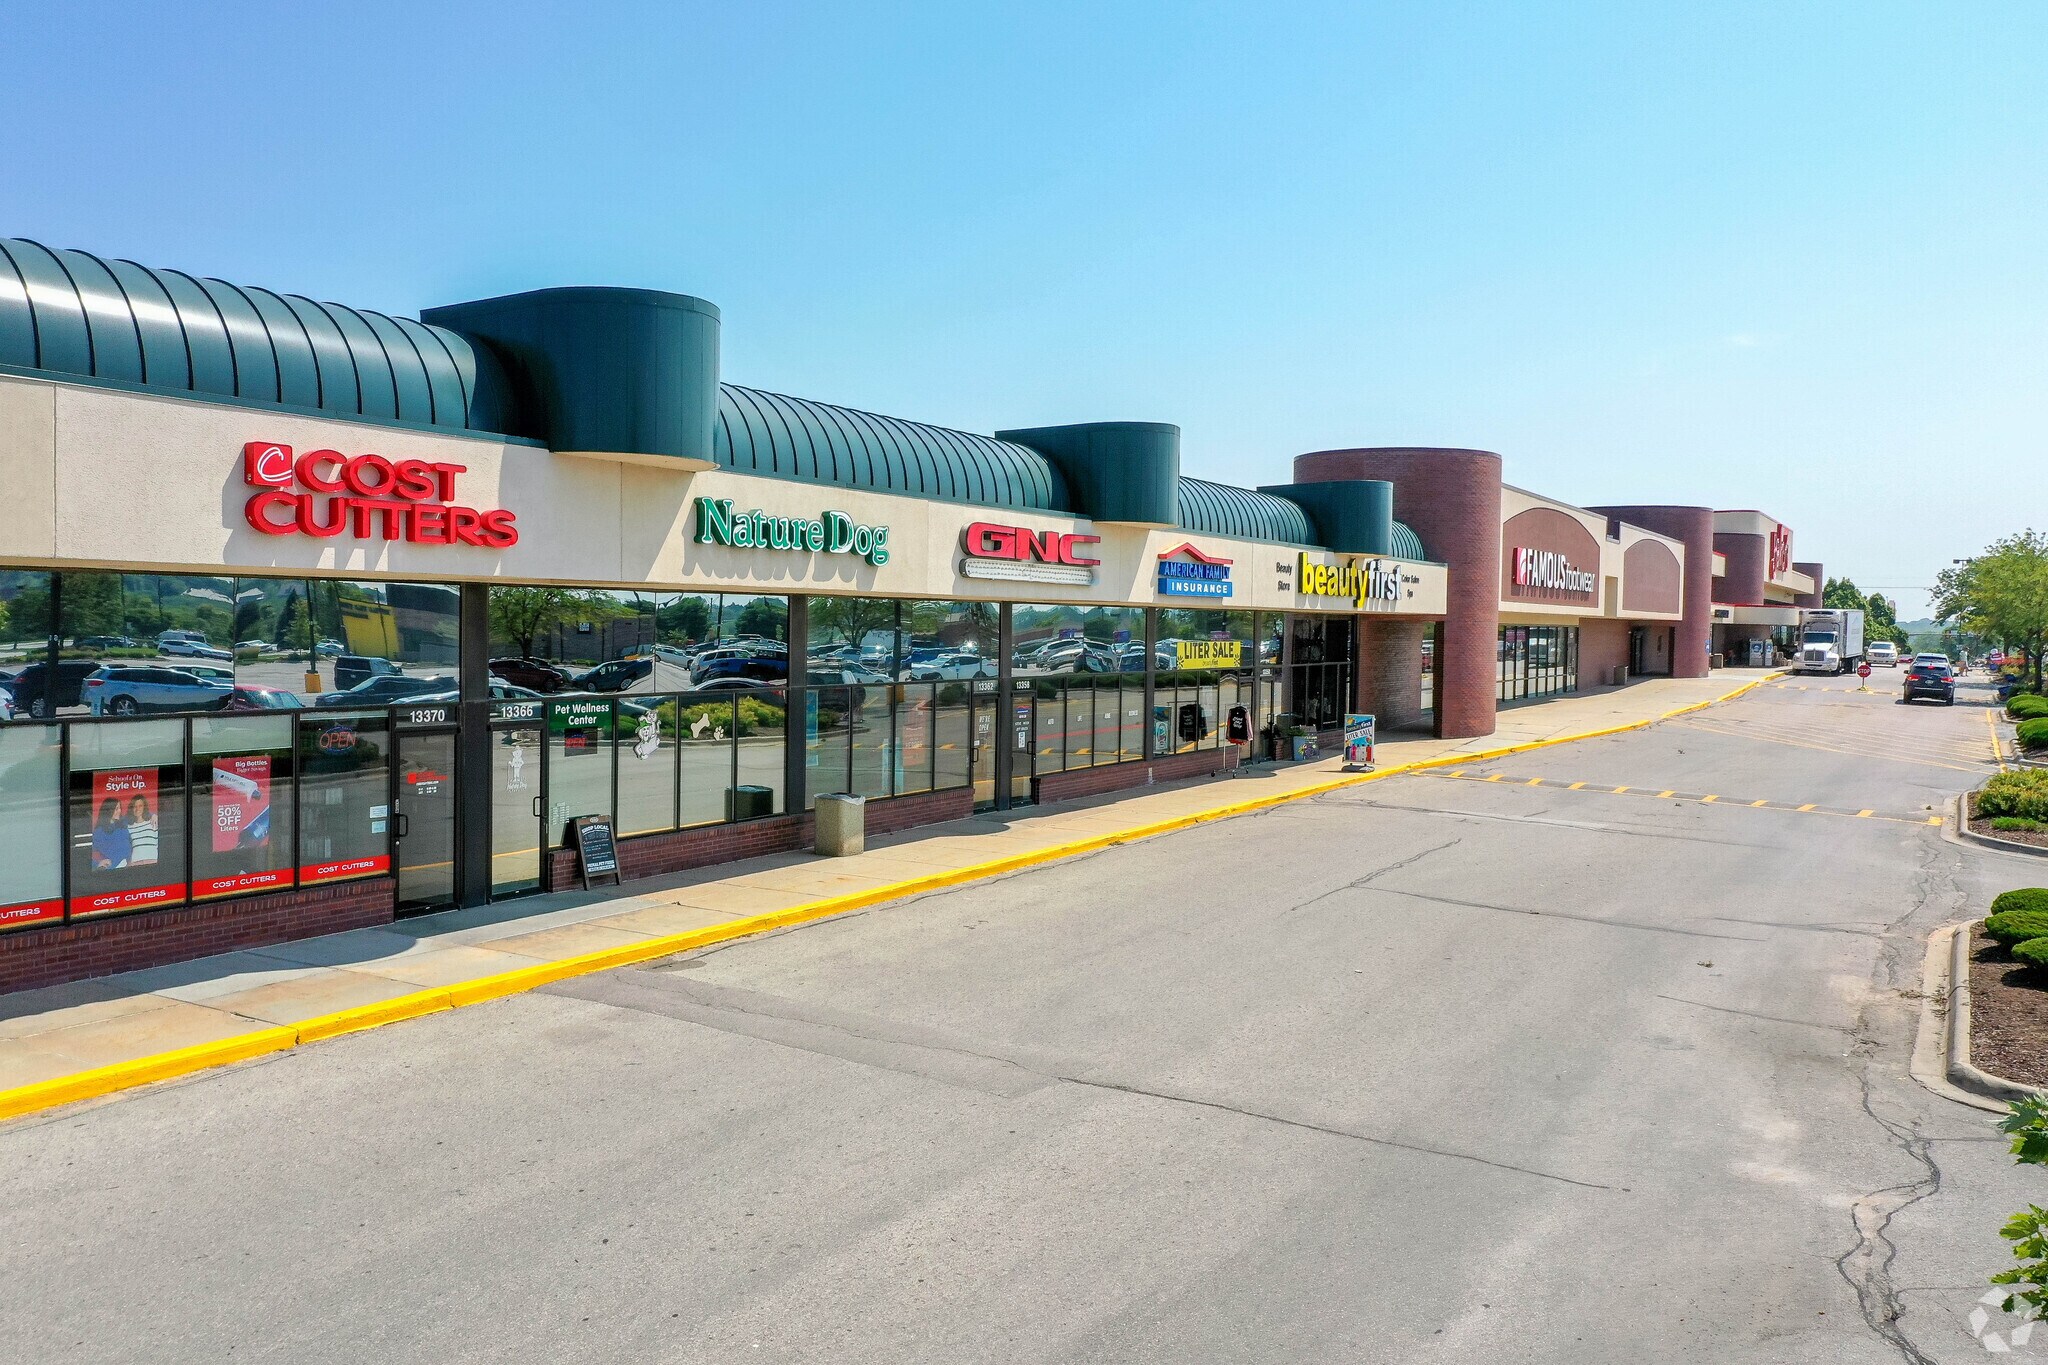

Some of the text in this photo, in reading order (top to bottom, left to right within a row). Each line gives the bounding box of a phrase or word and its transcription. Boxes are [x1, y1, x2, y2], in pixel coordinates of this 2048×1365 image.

[295, 449, 467, 501] COST
[245, 491, 518, 547] CUTTERS
[960, 521, 1100, 565] GNC
[1164, 561, 1231, 579] AMERICAN FAMILY
[1276, 561, 1292, 576] Beauty
[1171, 581, 1228, 594] INSURANCE
[1277, 581, 1291, 592] Store
[1184, 641, 1234, 659] LITER SALE
[501, 705, 534, 719] 13366
[554, 702, 610, 715] Pet Wellness
[410, 709, 446, 723] 13370
[567, 715, 598, 726] Center
[319, 731, 357, 748] OPEN
[105, 780, 147, 792] Style Up.
[217, 806, 242, 817] 50%
[217, 815, 241, 826] OFF
[317, 860, 375, 874] COST CUTTERS
[212, 874, 277, 889] COST CUTTERS
[93, 889, 166, 906] COST CUTTERS
[0, 907, 41, 919] UTTERS
